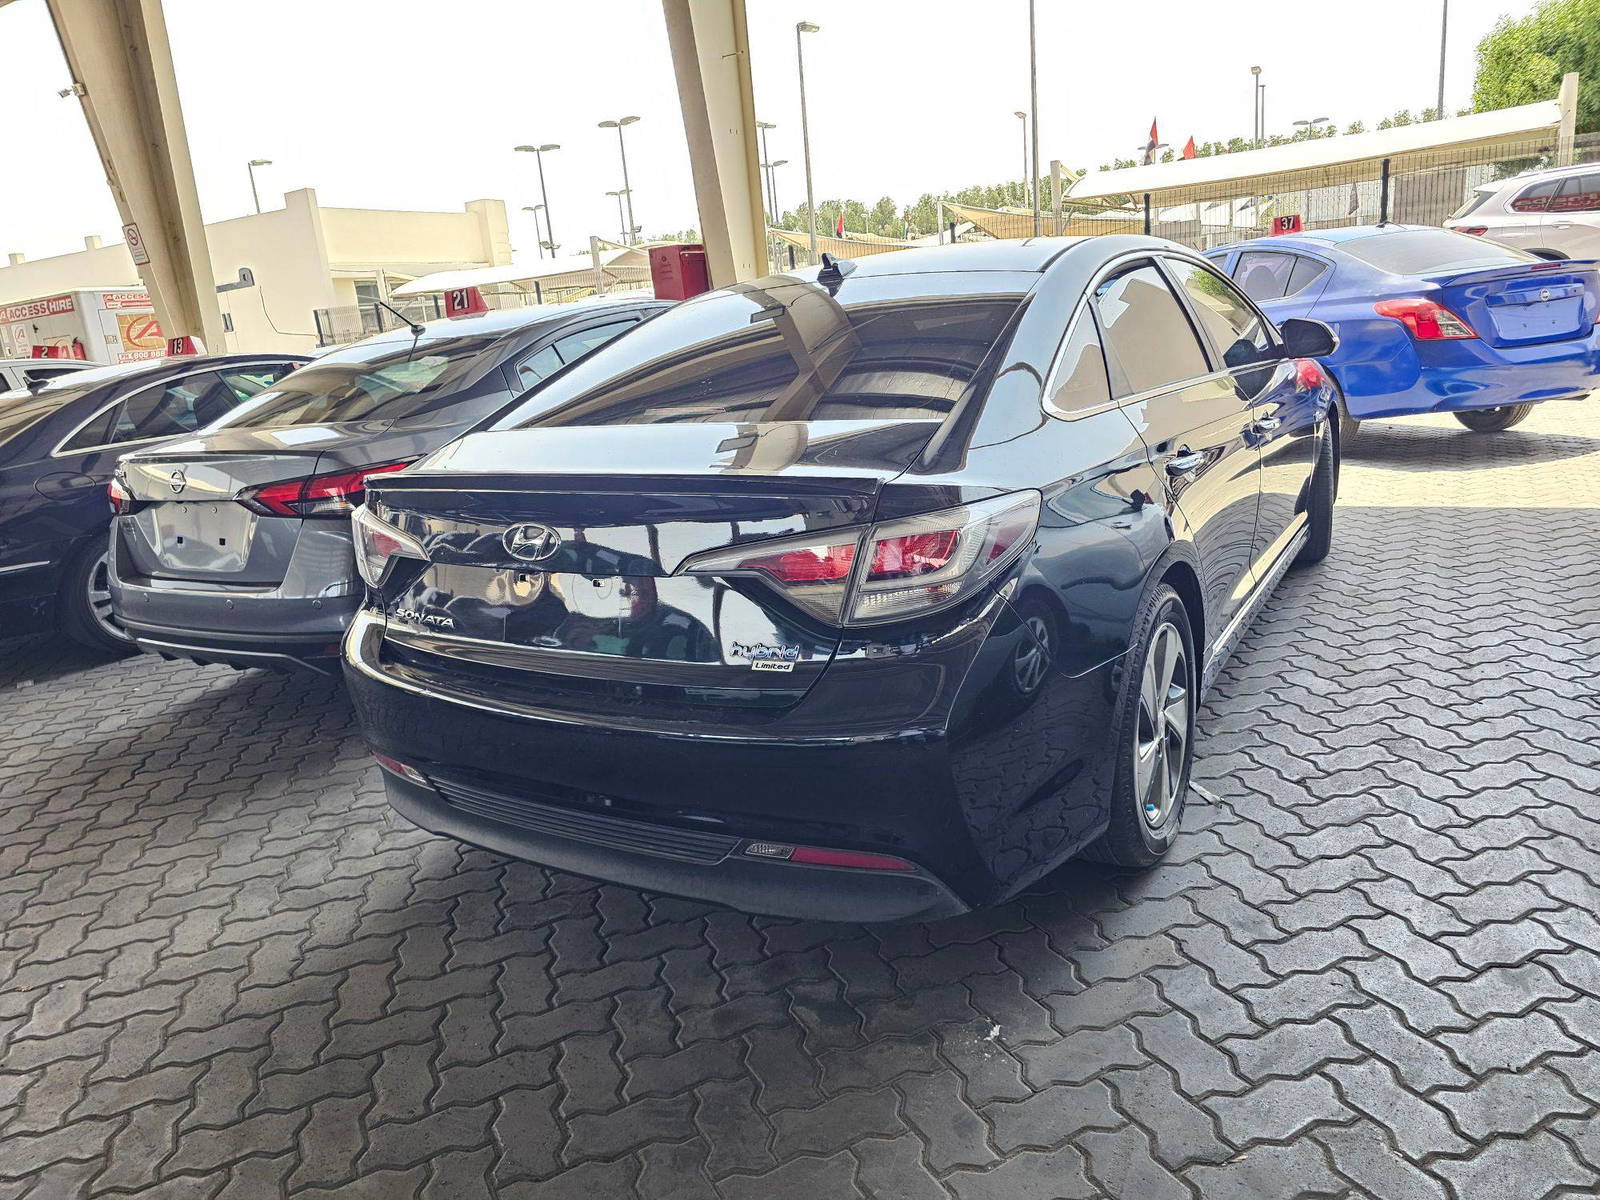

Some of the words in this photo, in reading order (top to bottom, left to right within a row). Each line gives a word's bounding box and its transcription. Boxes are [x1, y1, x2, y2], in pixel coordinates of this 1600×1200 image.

[1281, 216, 1294, 230] 37
[453, 289, 469, 310] 21
[9, 303, 47, 319] ACCESS
[48, 298, 73, 313] HIRE
[41, 346, 49, 358] 2
[173, 339, 184, 354] 13
[396, 608, 456, 629] SONATA
[730, 641, 800, 661] hybrid
[755, 662, 791, 670] Limited
